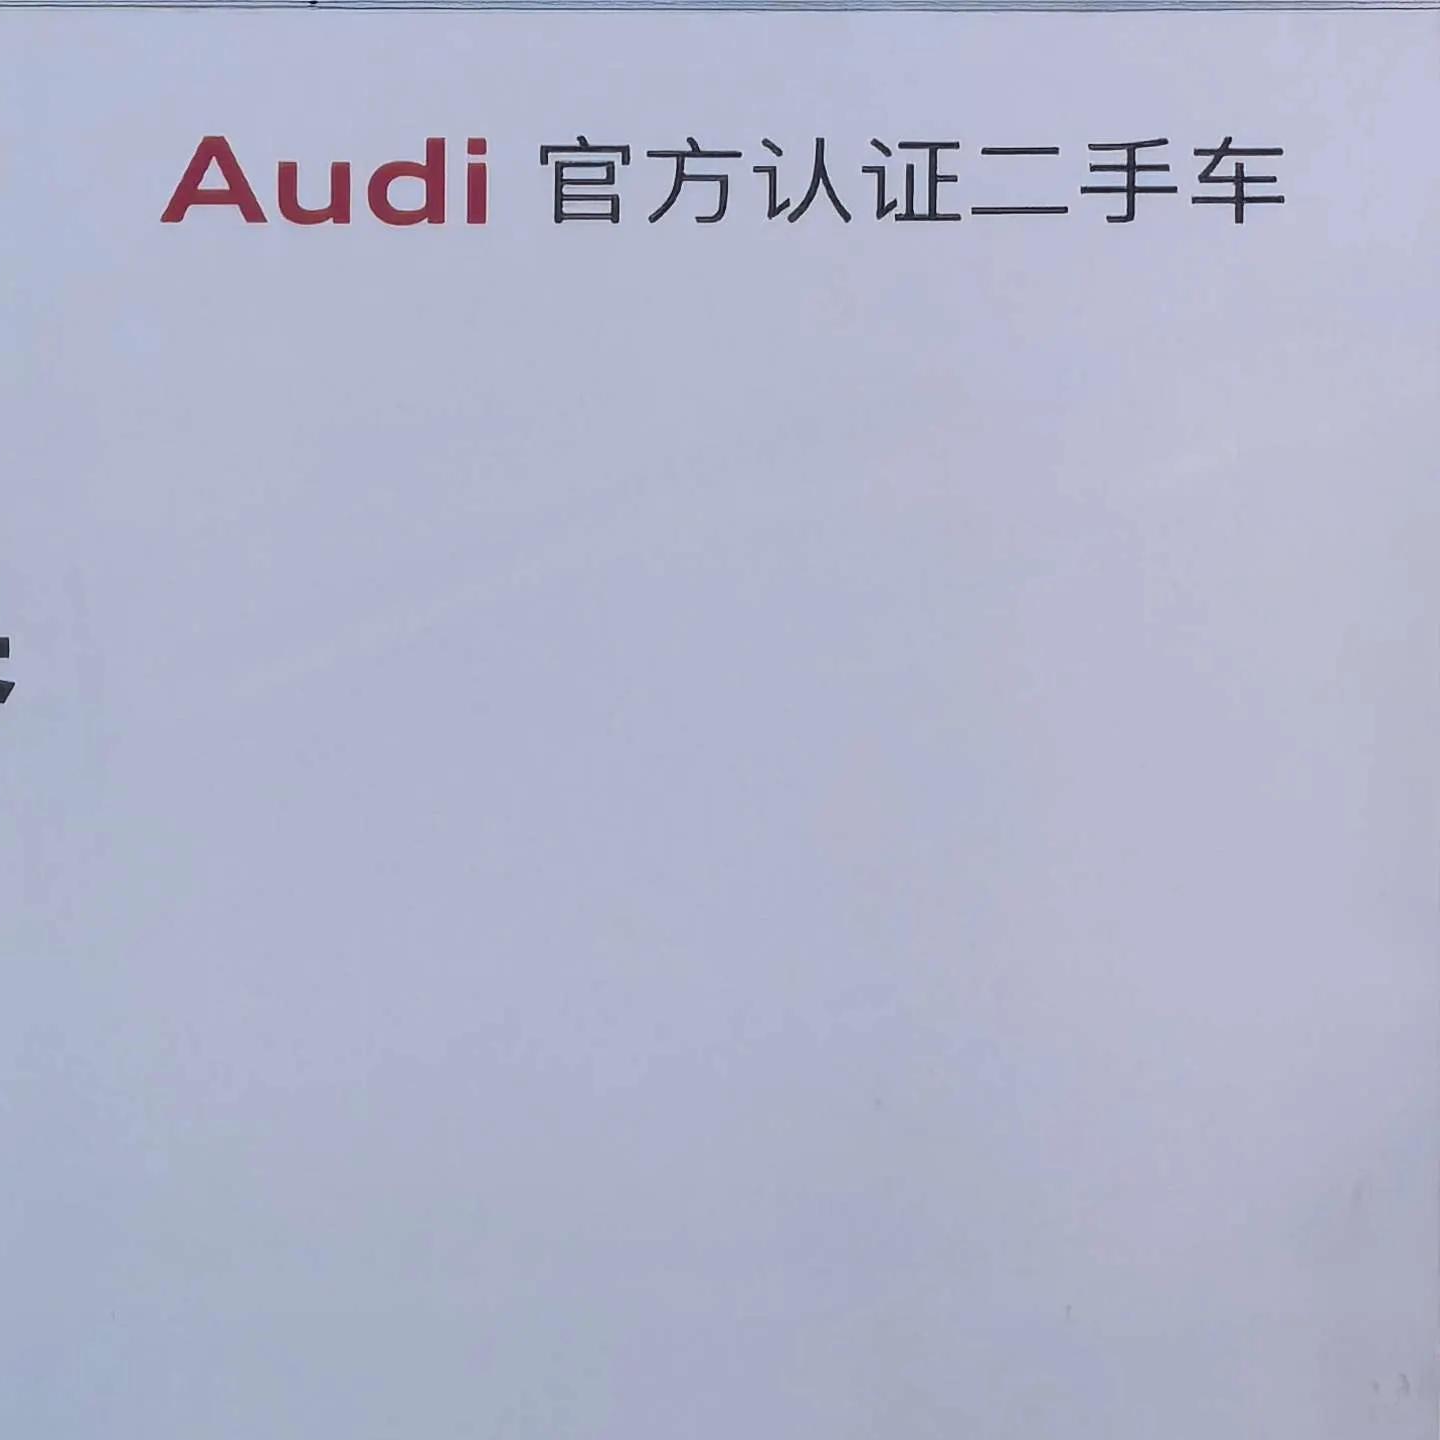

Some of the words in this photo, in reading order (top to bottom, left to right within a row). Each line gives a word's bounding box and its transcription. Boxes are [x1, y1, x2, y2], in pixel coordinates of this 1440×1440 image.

[160, 136, 489, 226] Audi
[539, 135, 1287, 225] 官方认证二手车
